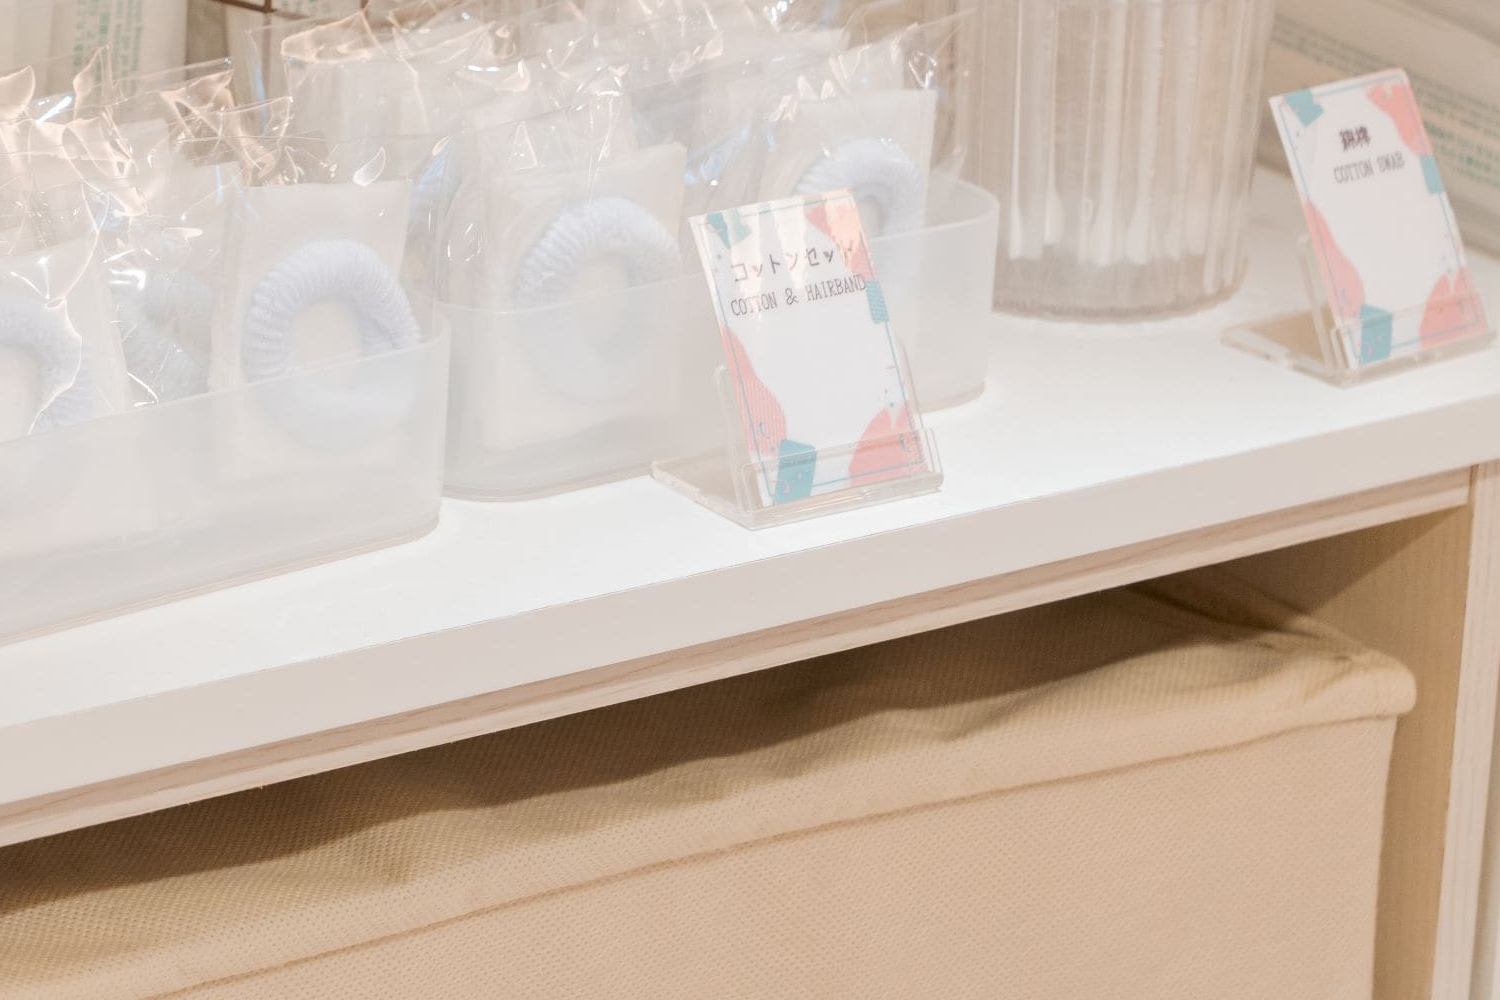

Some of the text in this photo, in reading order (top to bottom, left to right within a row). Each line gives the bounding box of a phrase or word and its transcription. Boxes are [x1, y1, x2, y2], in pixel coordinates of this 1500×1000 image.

[1332, 159, 1374, 184] COTTON
[731, 274, 867, 316] COTTON & HAIRBAND
